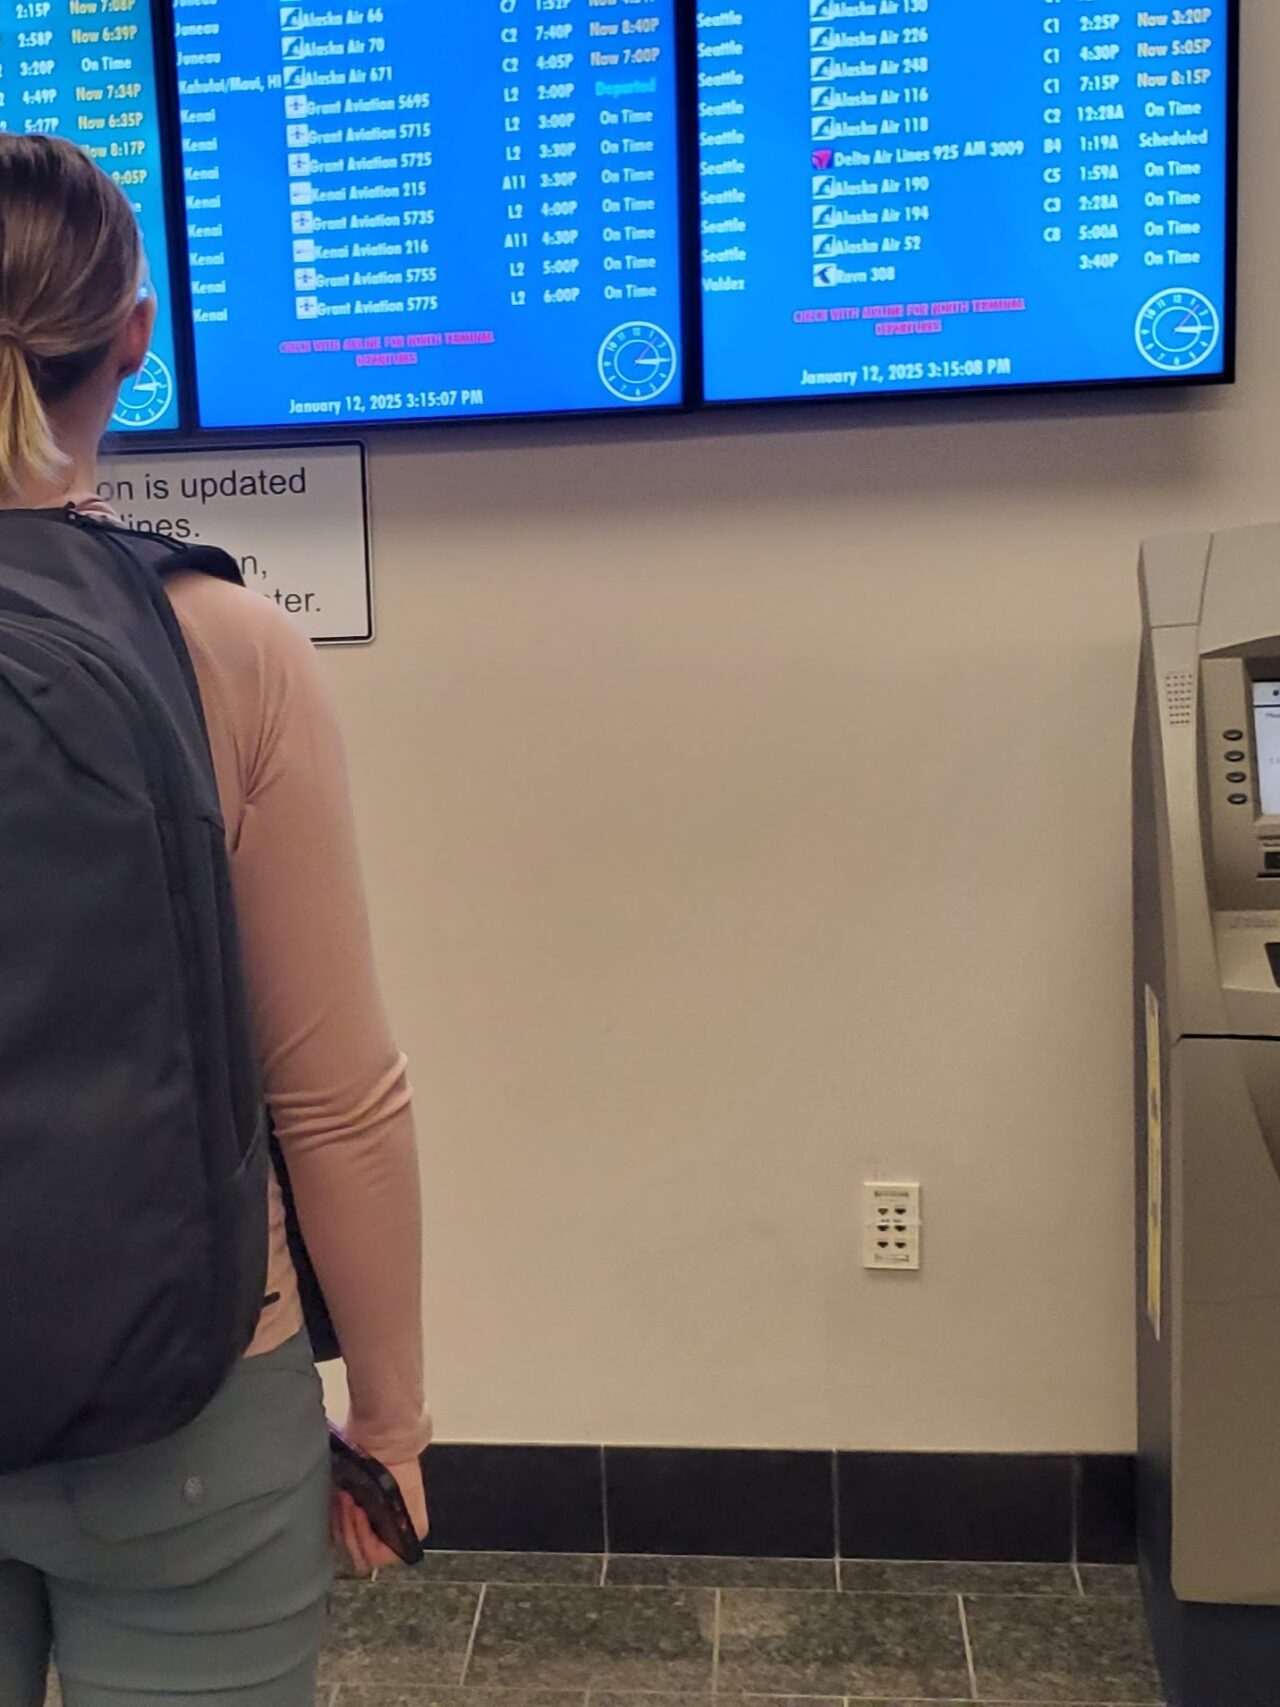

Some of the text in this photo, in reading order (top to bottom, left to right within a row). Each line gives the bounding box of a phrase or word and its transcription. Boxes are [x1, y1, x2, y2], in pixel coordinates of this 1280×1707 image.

[17, 30, 53, 48] 2:58P
[71, 28, 100, 44] Now
[102, 24, 138, 42] 6:39P
[347, 39, 365, 54] Air
[369, 37, 385, 52] 70
[501, 27, 518, 43] C2
[589, 21, 619, 36] Now
[879, 30, 899, 45] Air
[902, 27, 928, 44] 226
[1043, 17, 1060, 34] C1
[1080, 13, 1120, 32] 2:25P
[1137, 11, 1169, 27] Now
[1171, 7, 1212, 26] 3:20P
[20, 59, 55, 76] 3:20P
[81, 57, 99, 72] On
[101, 56, 132, 70] Time
[22, 88, 57, 104] 4:49P
[75, 86, 103, 101] Now
[106, 83, 142, 99] 7:34P
[308, 130, 343, 144] Grant
[346, 127, 397, 142] Aviation
[399, 122, 431, 139] 5715
[505, 116, 520, 132] L2
[538, 112, 575, 129] 3:00P
[600, 110, 619, 125] On
[621, 109, 653, 123] Time
[835, 151, 871, 167] Delta
[873, 149, 893, 164] Air
[896, 148, 931, 163] Lines
[933, 144, 959, 160] 925
[990, 140, 1024, 157] 3009
[1080, 134, 1119, 151] 1:19A
[1139, 128, 1208, 148] Scheduled
[191, 255, 656, 294] Kenai Grant Aviation 5755 L2 5:00P On Time
[702, 276, 745, 291] Valdez
[1079, 252, 1119, 270] 3:40P
[1144, 250, 1164, 266] On
[1167, 249, 1201, 264] Time
[830, 307, 860, 321] WITH
[906, 302, 928, 317] FOR
[931, 300, 969, 316] NORTH
[972, 298, 1026, 313] TERMINAL
[800, 357, 1011, 386] January 12, 2025 3:15:08 PM
[289, 389, 483, 415] January 12, 2025 3:15:07 PM
[145, 473, 169, 500] is
[181, 467, 307, 506] updated
